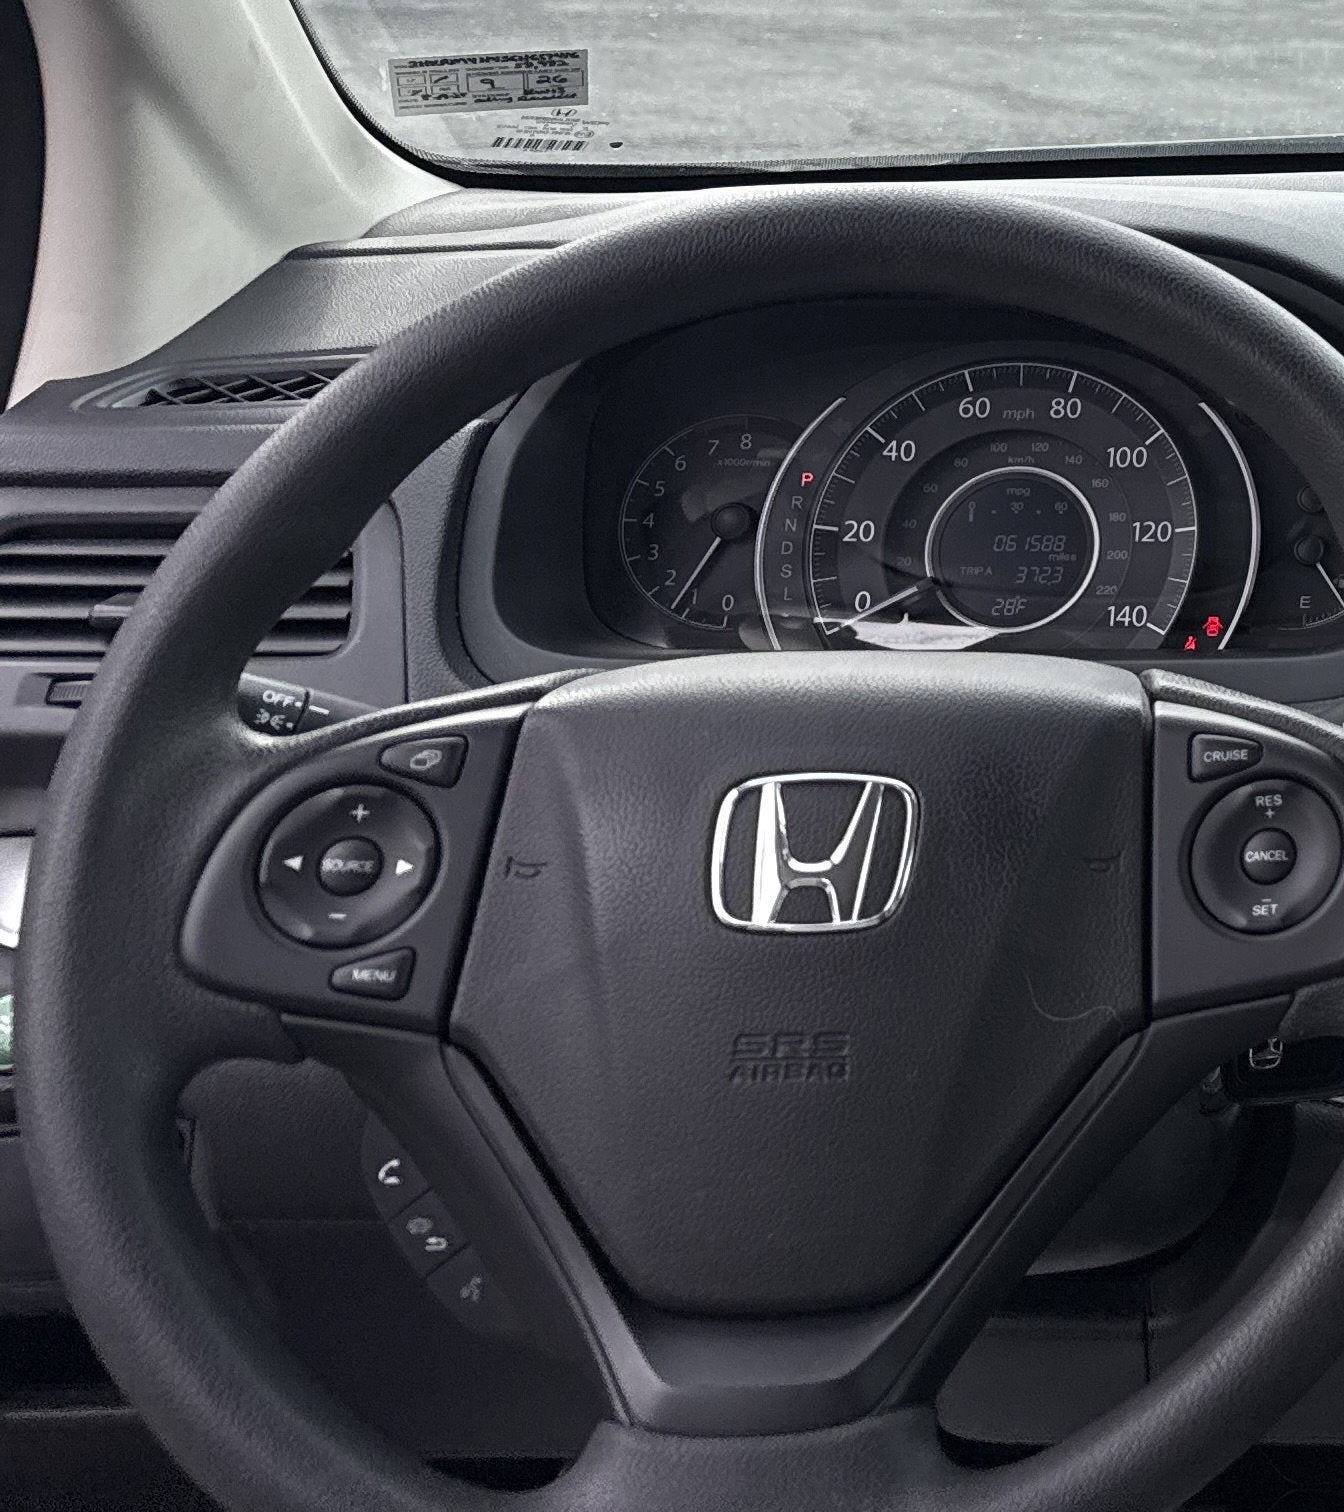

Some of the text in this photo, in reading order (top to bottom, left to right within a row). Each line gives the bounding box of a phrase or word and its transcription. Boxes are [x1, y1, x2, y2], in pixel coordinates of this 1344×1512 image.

[958, 397, 991, 419] 60
[1002, 408, 1035, 421] mph
[1050, 397, 1082, 419] 80
[708, 440, 719, 456] 7
[740, 433, 752, 450] 8
[990, 442, 1008, 452] 100
[1031, 442, 1050, 452] 120
[882, 439, 916, 462] 40
[1106, 446, 1148, 468] 100
[674, 455, 687, 472] 6
[1008, 455, 1035, 465] km/h
[1065, 455, 1083, 465] 140
[802, 472, 814, 487] P
[1091, 478, 1110, 488] 160
[654, 481, 666, 497] 5
[1007, 487, 1031, 497] mpg
[791, 496, 803, 509] R
[1010, 501, 1024, 511] 30
[642, 513, 655, 529] 4
[1108, 512, 1127, 522] 180
[784, 519, 797, 532] N
[842, 520, 876, 542] 20
[1132, 520, 1172, 542] 120
[780, 541, 793, 555] D
[993, 534, 1066, 552] 061588
[647, 544, 659, 561] 3
[1048, 552, 1077, 561] miles
[1106, 549, 1128, 560] 200
[664, 569, 677, 587] 2
[780, 563, 792, 578] S
[960, 566, 993, 576] TRIP A
[691, 588, 698, 605] 1
[784, 587, 793, 602] L
[855, 590, 871, 613] 0
[1300, 595, 1312, 608] E
[721, 594, 735, 612] 0
[1107, 605, 1148, 627] 140
[1203, 748, 1249, 763] CRUISE
[1255, 793, 1283, 807] RES
[1244, 850, 1289, 863] CANCEL
[1251, 903, 1279, 916] SET
[351, 968, 398, 983] MENU
